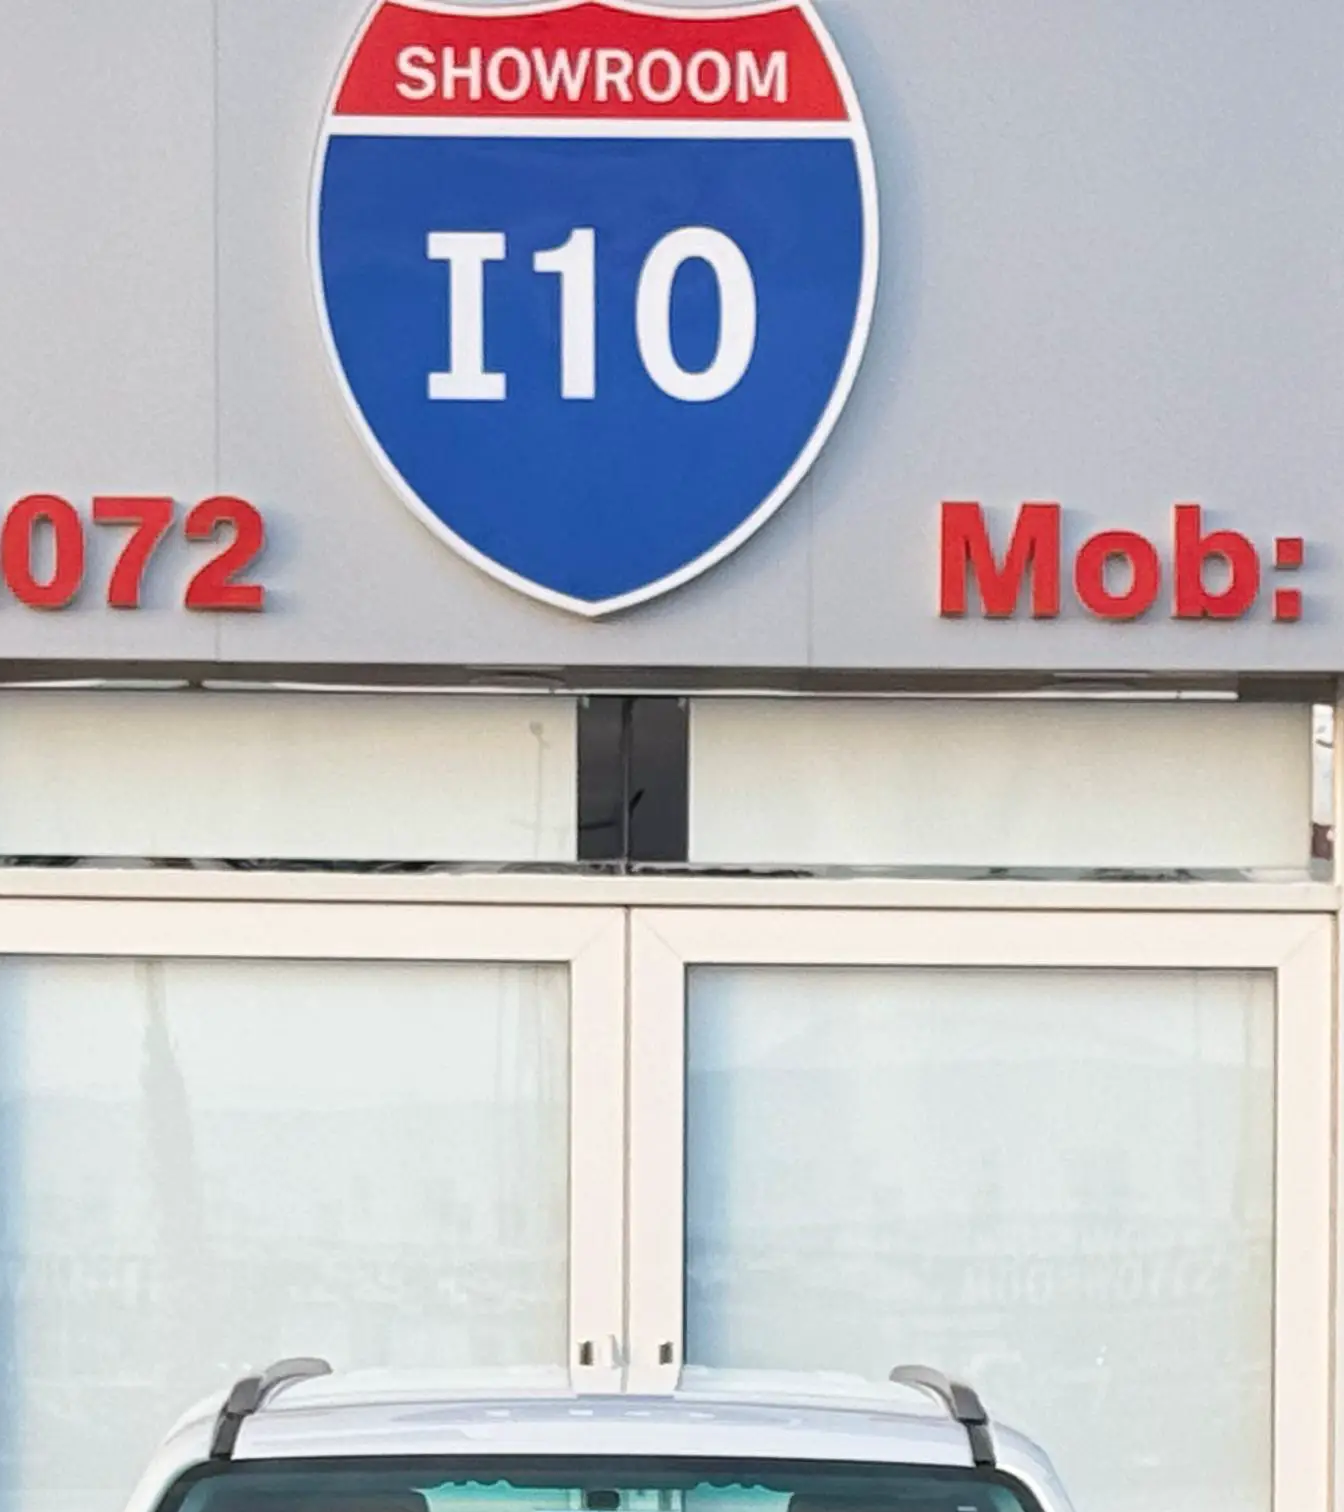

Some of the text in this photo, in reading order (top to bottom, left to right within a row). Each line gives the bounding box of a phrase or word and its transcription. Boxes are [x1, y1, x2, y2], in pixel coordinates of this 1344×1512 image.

[395, 46, 789, 103] SHOWROOM
[426, 225, 757, 402] I10
[938, 500, 1304, 620] Mob:
